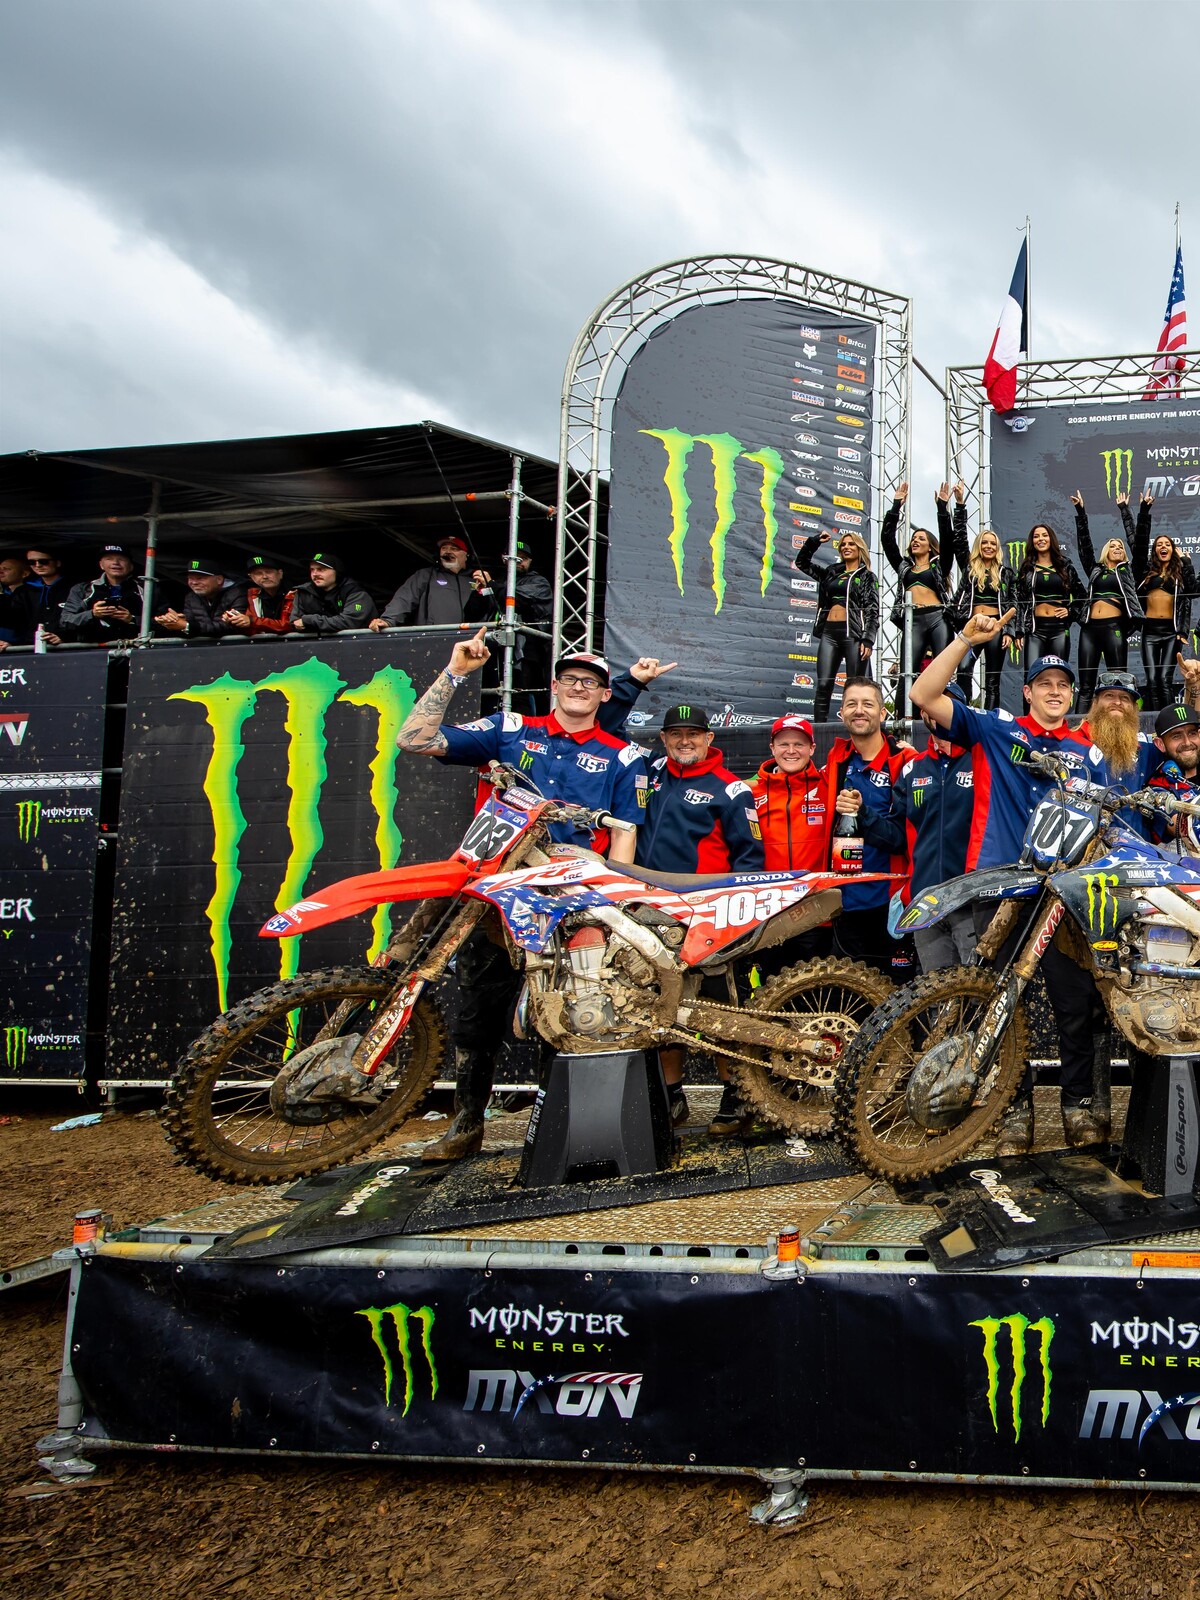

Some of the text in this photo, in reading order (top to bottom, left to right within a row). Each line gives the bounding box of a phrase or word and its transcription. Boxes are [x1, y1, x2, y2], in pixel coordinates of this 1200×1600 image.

[841, 400, 866, 413] THOR
[1068, 414, 1087, 424] 2022
[1089, 412, 1128, 423] MONSTER
[1129, 411, 1161, 421] ENERGY
[1163, 410, 1177, 418] FIM
[792, 472, 820, 481] OAKLEY
[834, 465, 864, 476] NAMURA
[837, 482, 860, 494] FXR
[788, 654, 818, 662] HINSON
[519, 740, 548, 755] AMA
[578, 756, 606, 772] USA
[684, 791, 711, 804] USA
[41, 806, 94, 818] MONSTER
[1031, 805, 1092, 859] 101
[734, 872, 794, 883] HONDA
[1127, 869, 1157, 879] YAMALUBE
[708, 888, 783, 930] 103
[1032, 903, 1065, 958] KYB
[27, 1033, 81, 1045] MONSTER
[1176, 1083, 1187, 1177] Polisport
[469, 1303, 630, 1337] MONSTER
[495, 1338, 605, 1353] ENERGY
